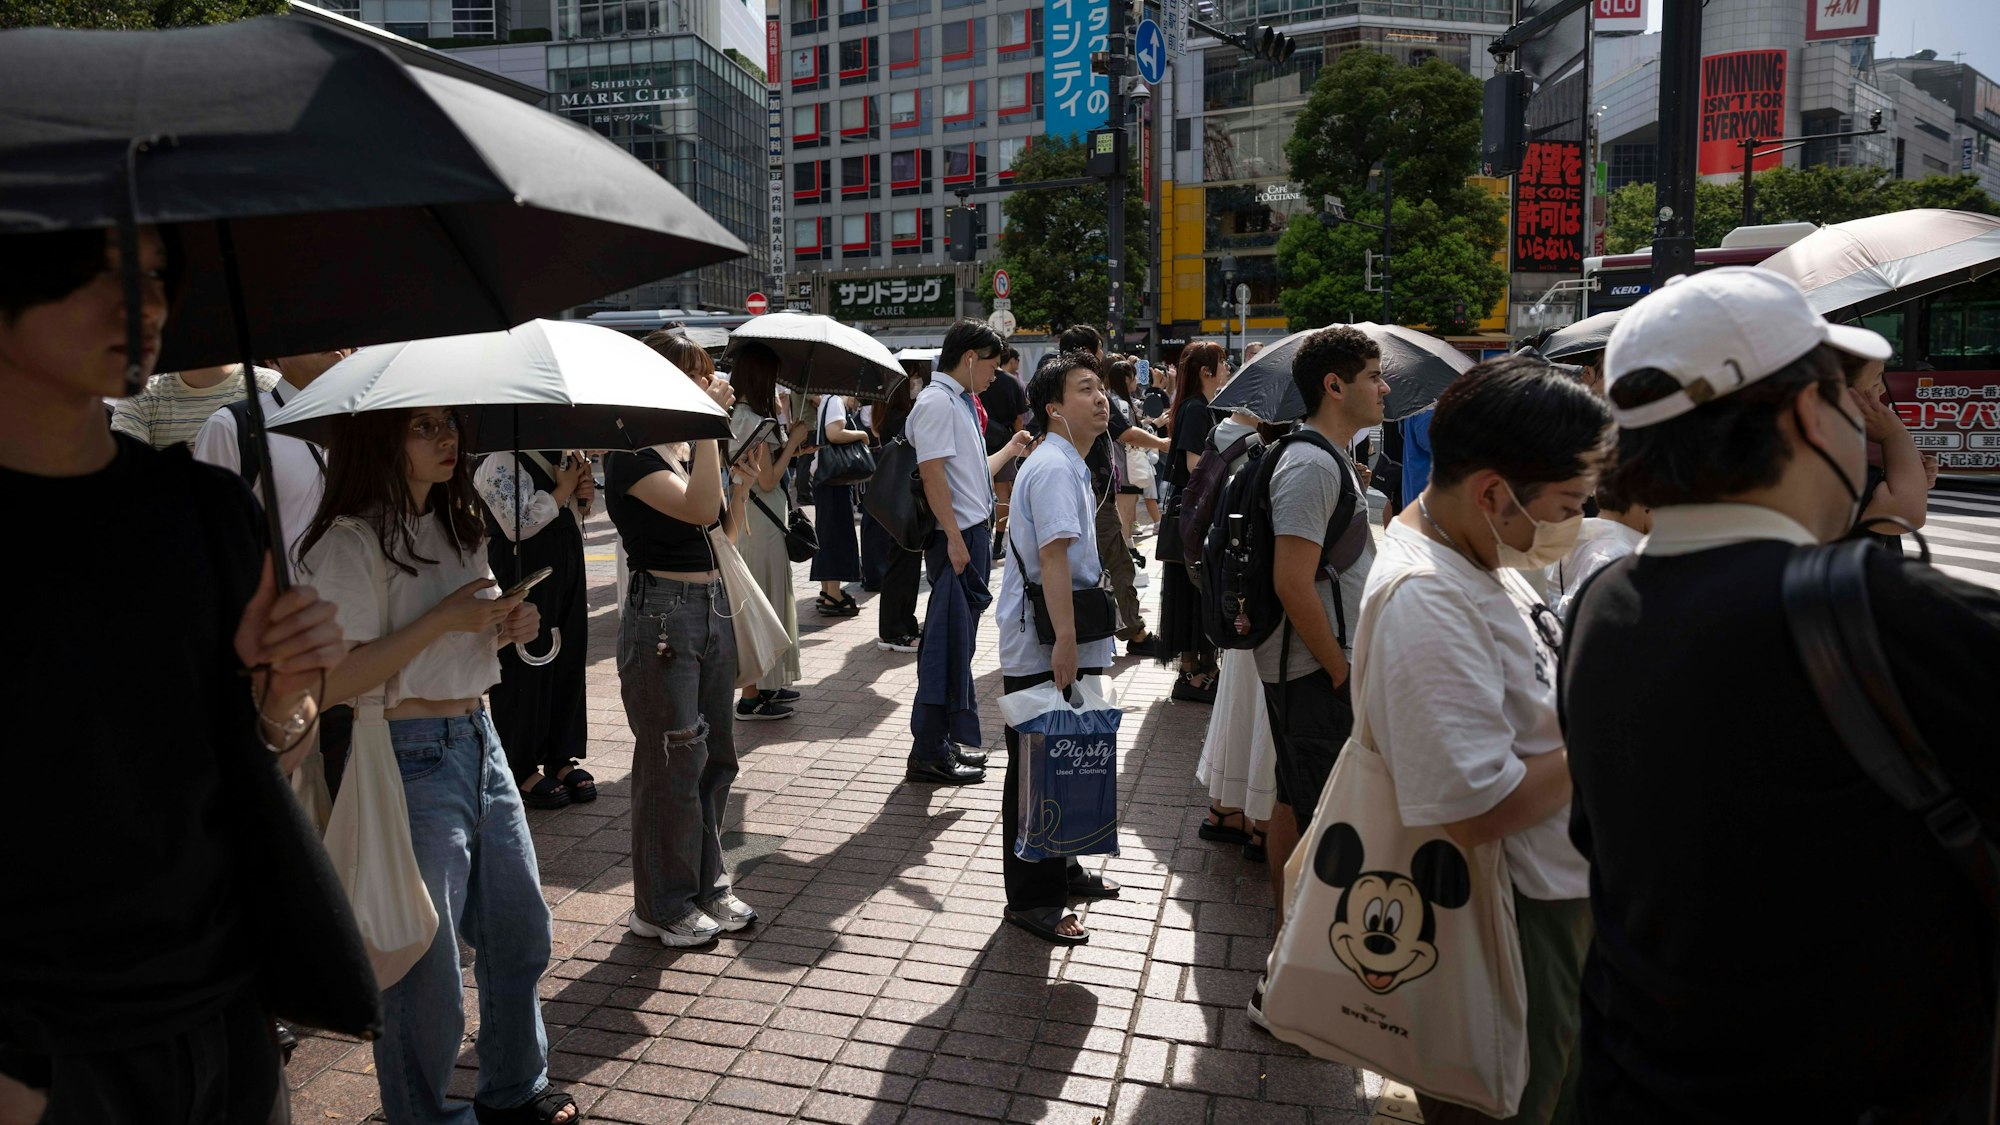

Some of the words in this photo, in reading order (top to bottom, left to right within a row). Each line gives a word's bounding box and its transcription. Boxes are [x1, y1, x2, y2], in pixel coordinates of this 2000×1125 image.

[1825, 0, 1859, 17] H&M
[1705, 52, 1783, 96] WINNING
[591, 79, 652, 90] SHIBUYA
[561, 92, 625, 106] MARK
[635, 87, 689, 101] CITY
[1704, 96, 1747, 114] ISN'T
[1751, 93, 1782, 109] FOR
[1703, 109, 1782, 142] EVERYONE.
[771, 172, 782, 180] 3F
[1518, 201, 1581, 235] 許可は
[1518, 236, 1581, 260] いらない。
[800, 284, 812, 295] 2F
[839, 279, 942, 306] サンドラッグ
[1611, 285, 1642, 295] KEIO
[873, 306, 905, 316] CARER
[1917, 386, 2000, 398] お客様の一番
[1889, 403, 2000, 428] ヨドバ
[1050, 739, 1117, 767] Pigsty
